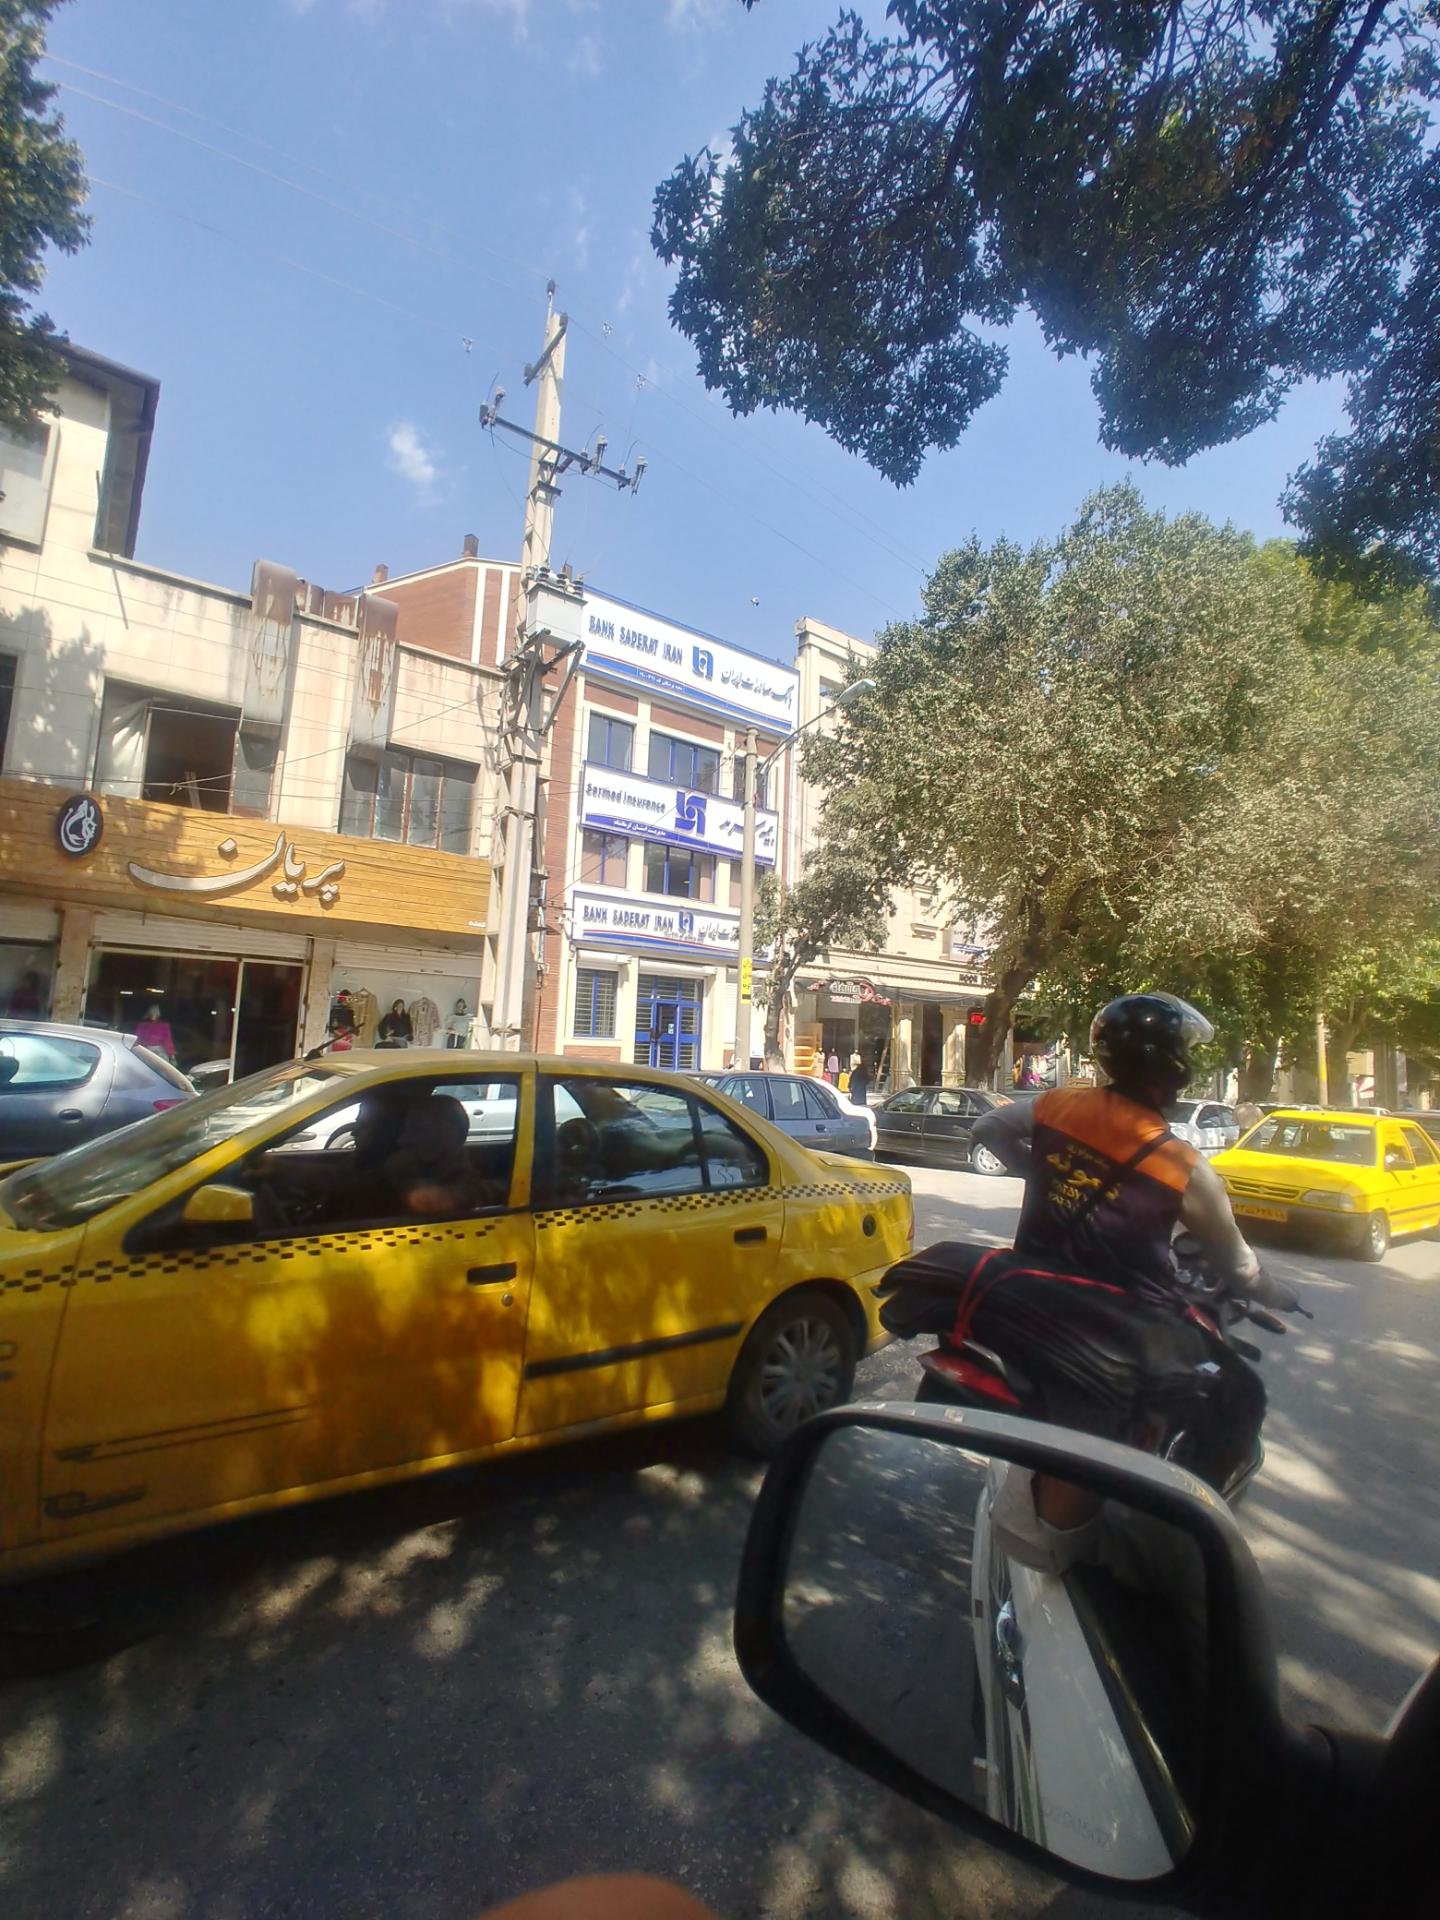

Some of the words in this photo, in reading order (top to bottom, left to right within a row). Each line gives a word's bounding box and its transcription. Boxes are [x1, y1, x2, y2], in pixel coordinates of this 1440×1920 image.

[589, 615, 614, 639] BANK
[619, 626, 659, 653] SADERAT
[663, 642, 683, 663] IRAN
[128, 831, 345, 904] پریان
[583, 905, 607, 922] BANK
[612, 909, 650, 927] SADERAT
[654, 915, 674, 930] IRAN
